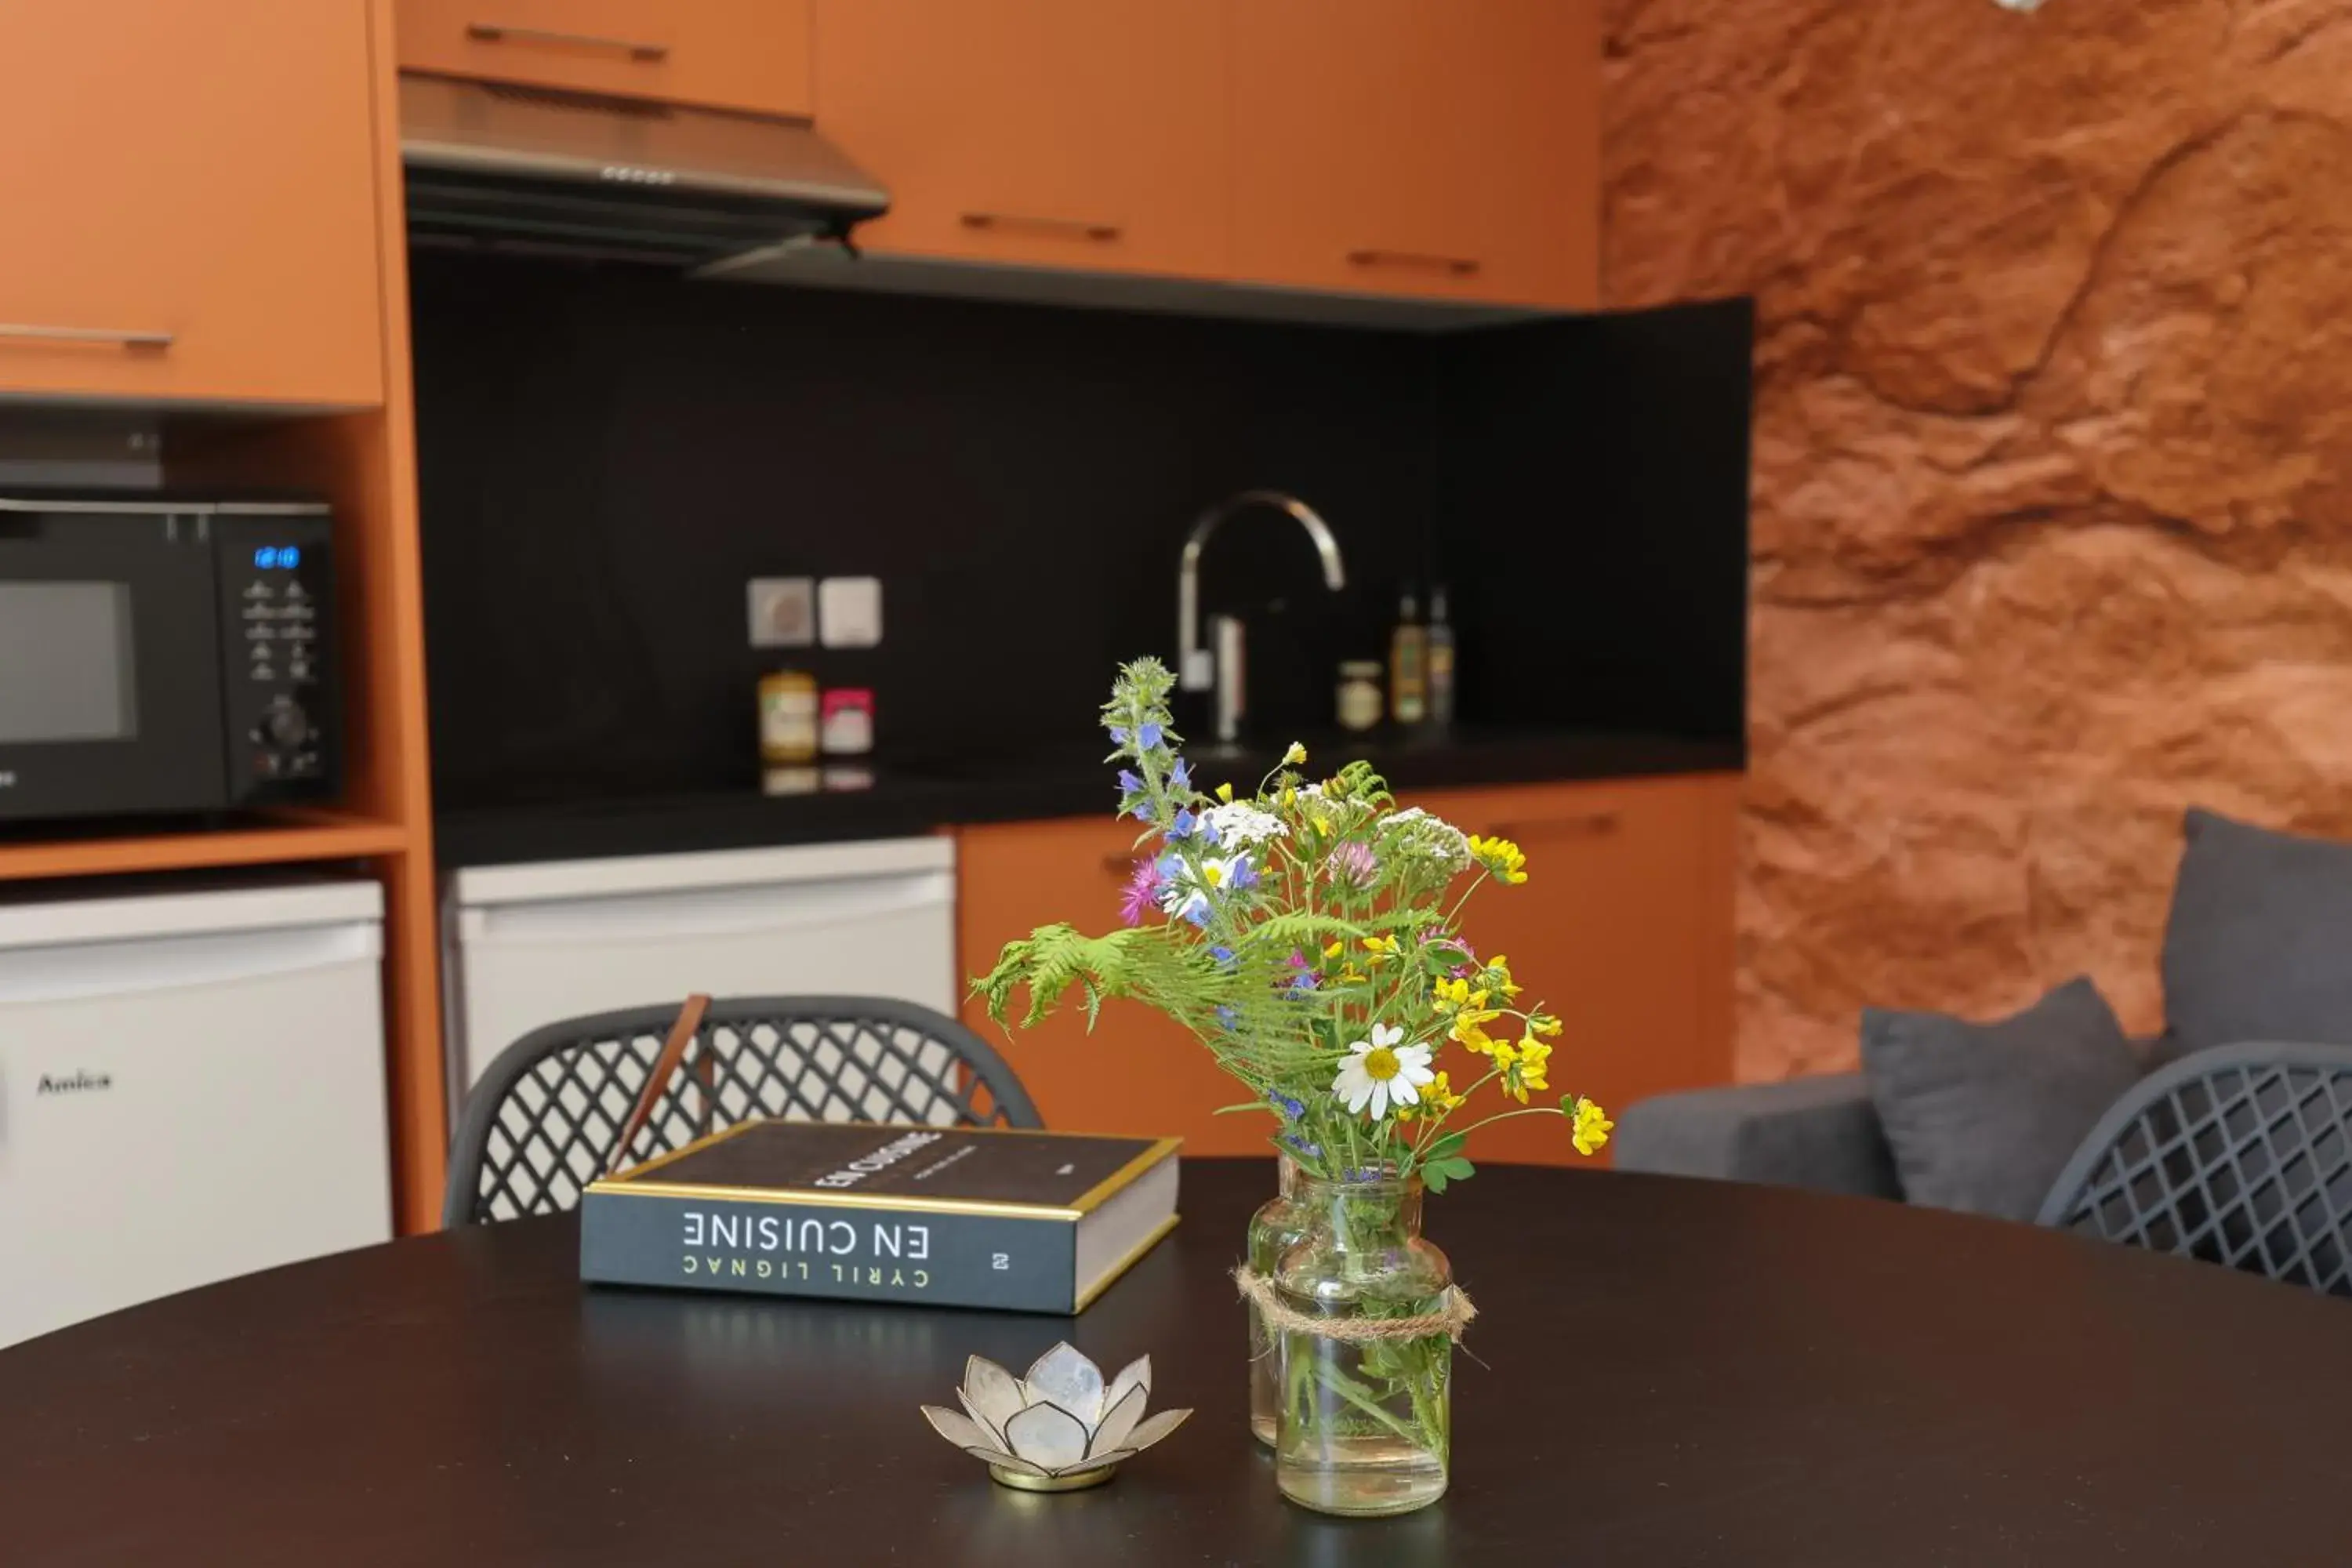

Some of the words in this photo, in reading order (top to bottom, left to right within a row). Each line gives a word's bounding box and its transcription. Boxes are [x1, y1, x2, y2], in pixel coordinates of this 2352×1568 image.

[683, 1212, 857, 1254] CUISINE
[874, 1223, 929, 1259] EN
[683, 1254, 808, 1281] LIGNAC
[831, 1263, 929, 1288] CYRIL
